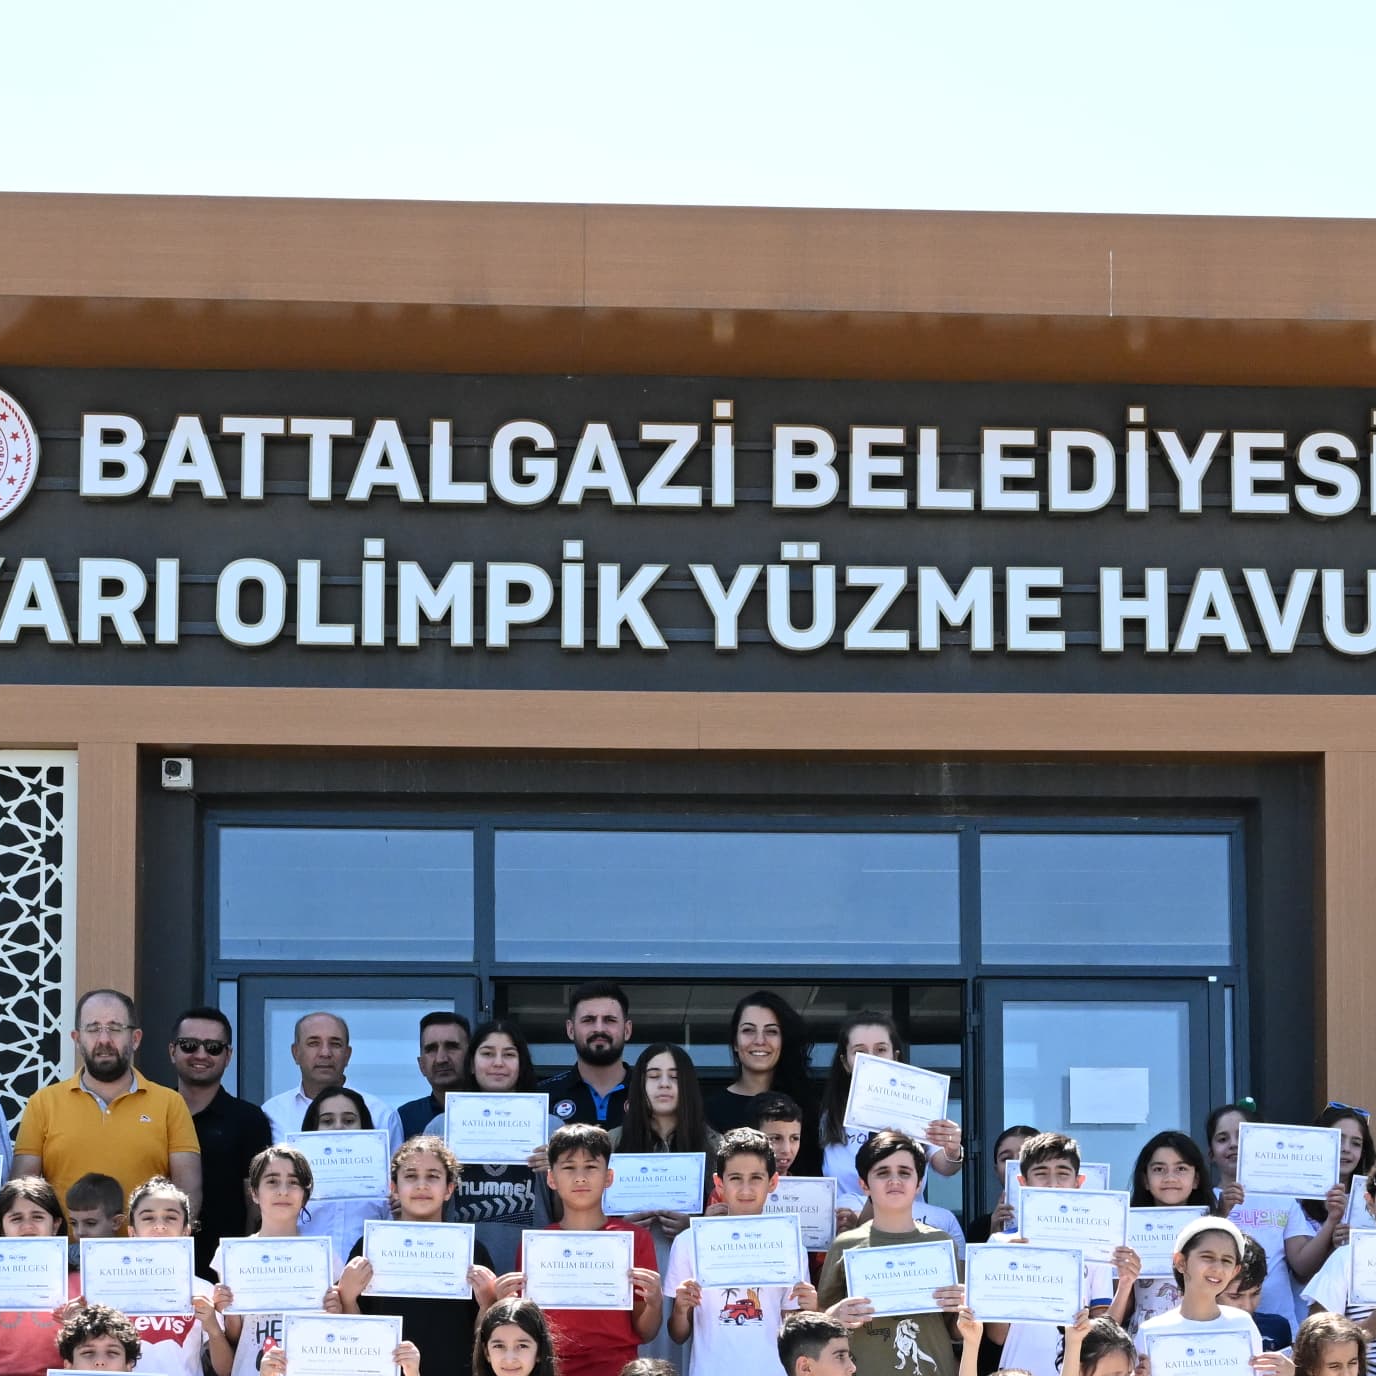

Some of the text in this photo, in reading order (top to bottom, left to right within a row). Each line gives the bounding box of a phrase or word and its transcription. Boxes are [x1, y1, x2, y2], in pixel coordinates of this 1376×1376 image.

[82, 403, 732, 506] BATTALGAZİ
[217, 539, 669, 649] OLİMPİK
[691, 542, 1066, 651] YÜZME
[310, 1157, 337, 1166] ATILIM
[457, 1177, 534, 1198] hummel
[765, 1205, 784, 1214] ILIM
[134, 1316, 185, 1334] evi's
